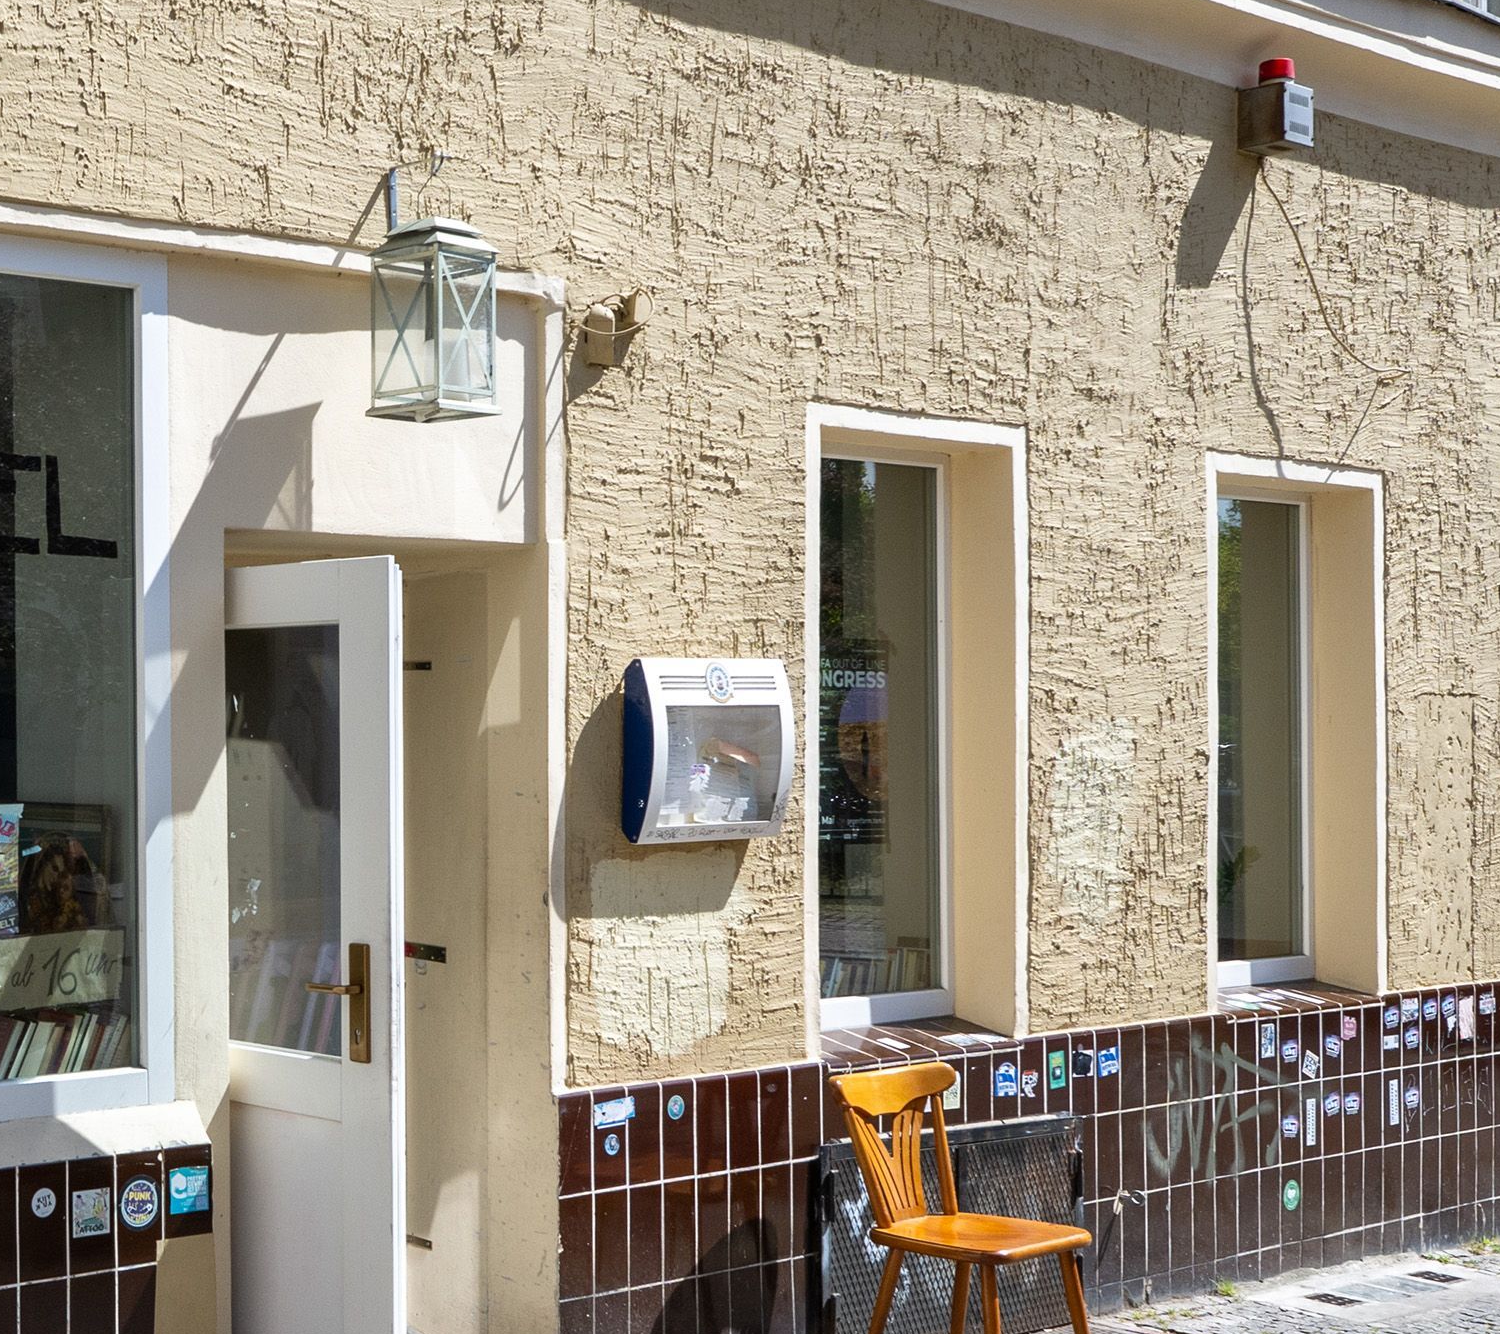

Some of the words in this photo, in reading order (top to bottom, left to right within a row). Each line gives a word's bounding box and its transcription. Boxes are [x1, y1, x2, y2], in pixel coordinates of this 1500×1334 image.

[820, 670, 886, 688] NGRESS
[11, 954, 35, 987] ab
[41, 946, 81, 997] 16
[85, 951, 118, 976] Uhr
[129, 1191, 151, 1201] PUNK
